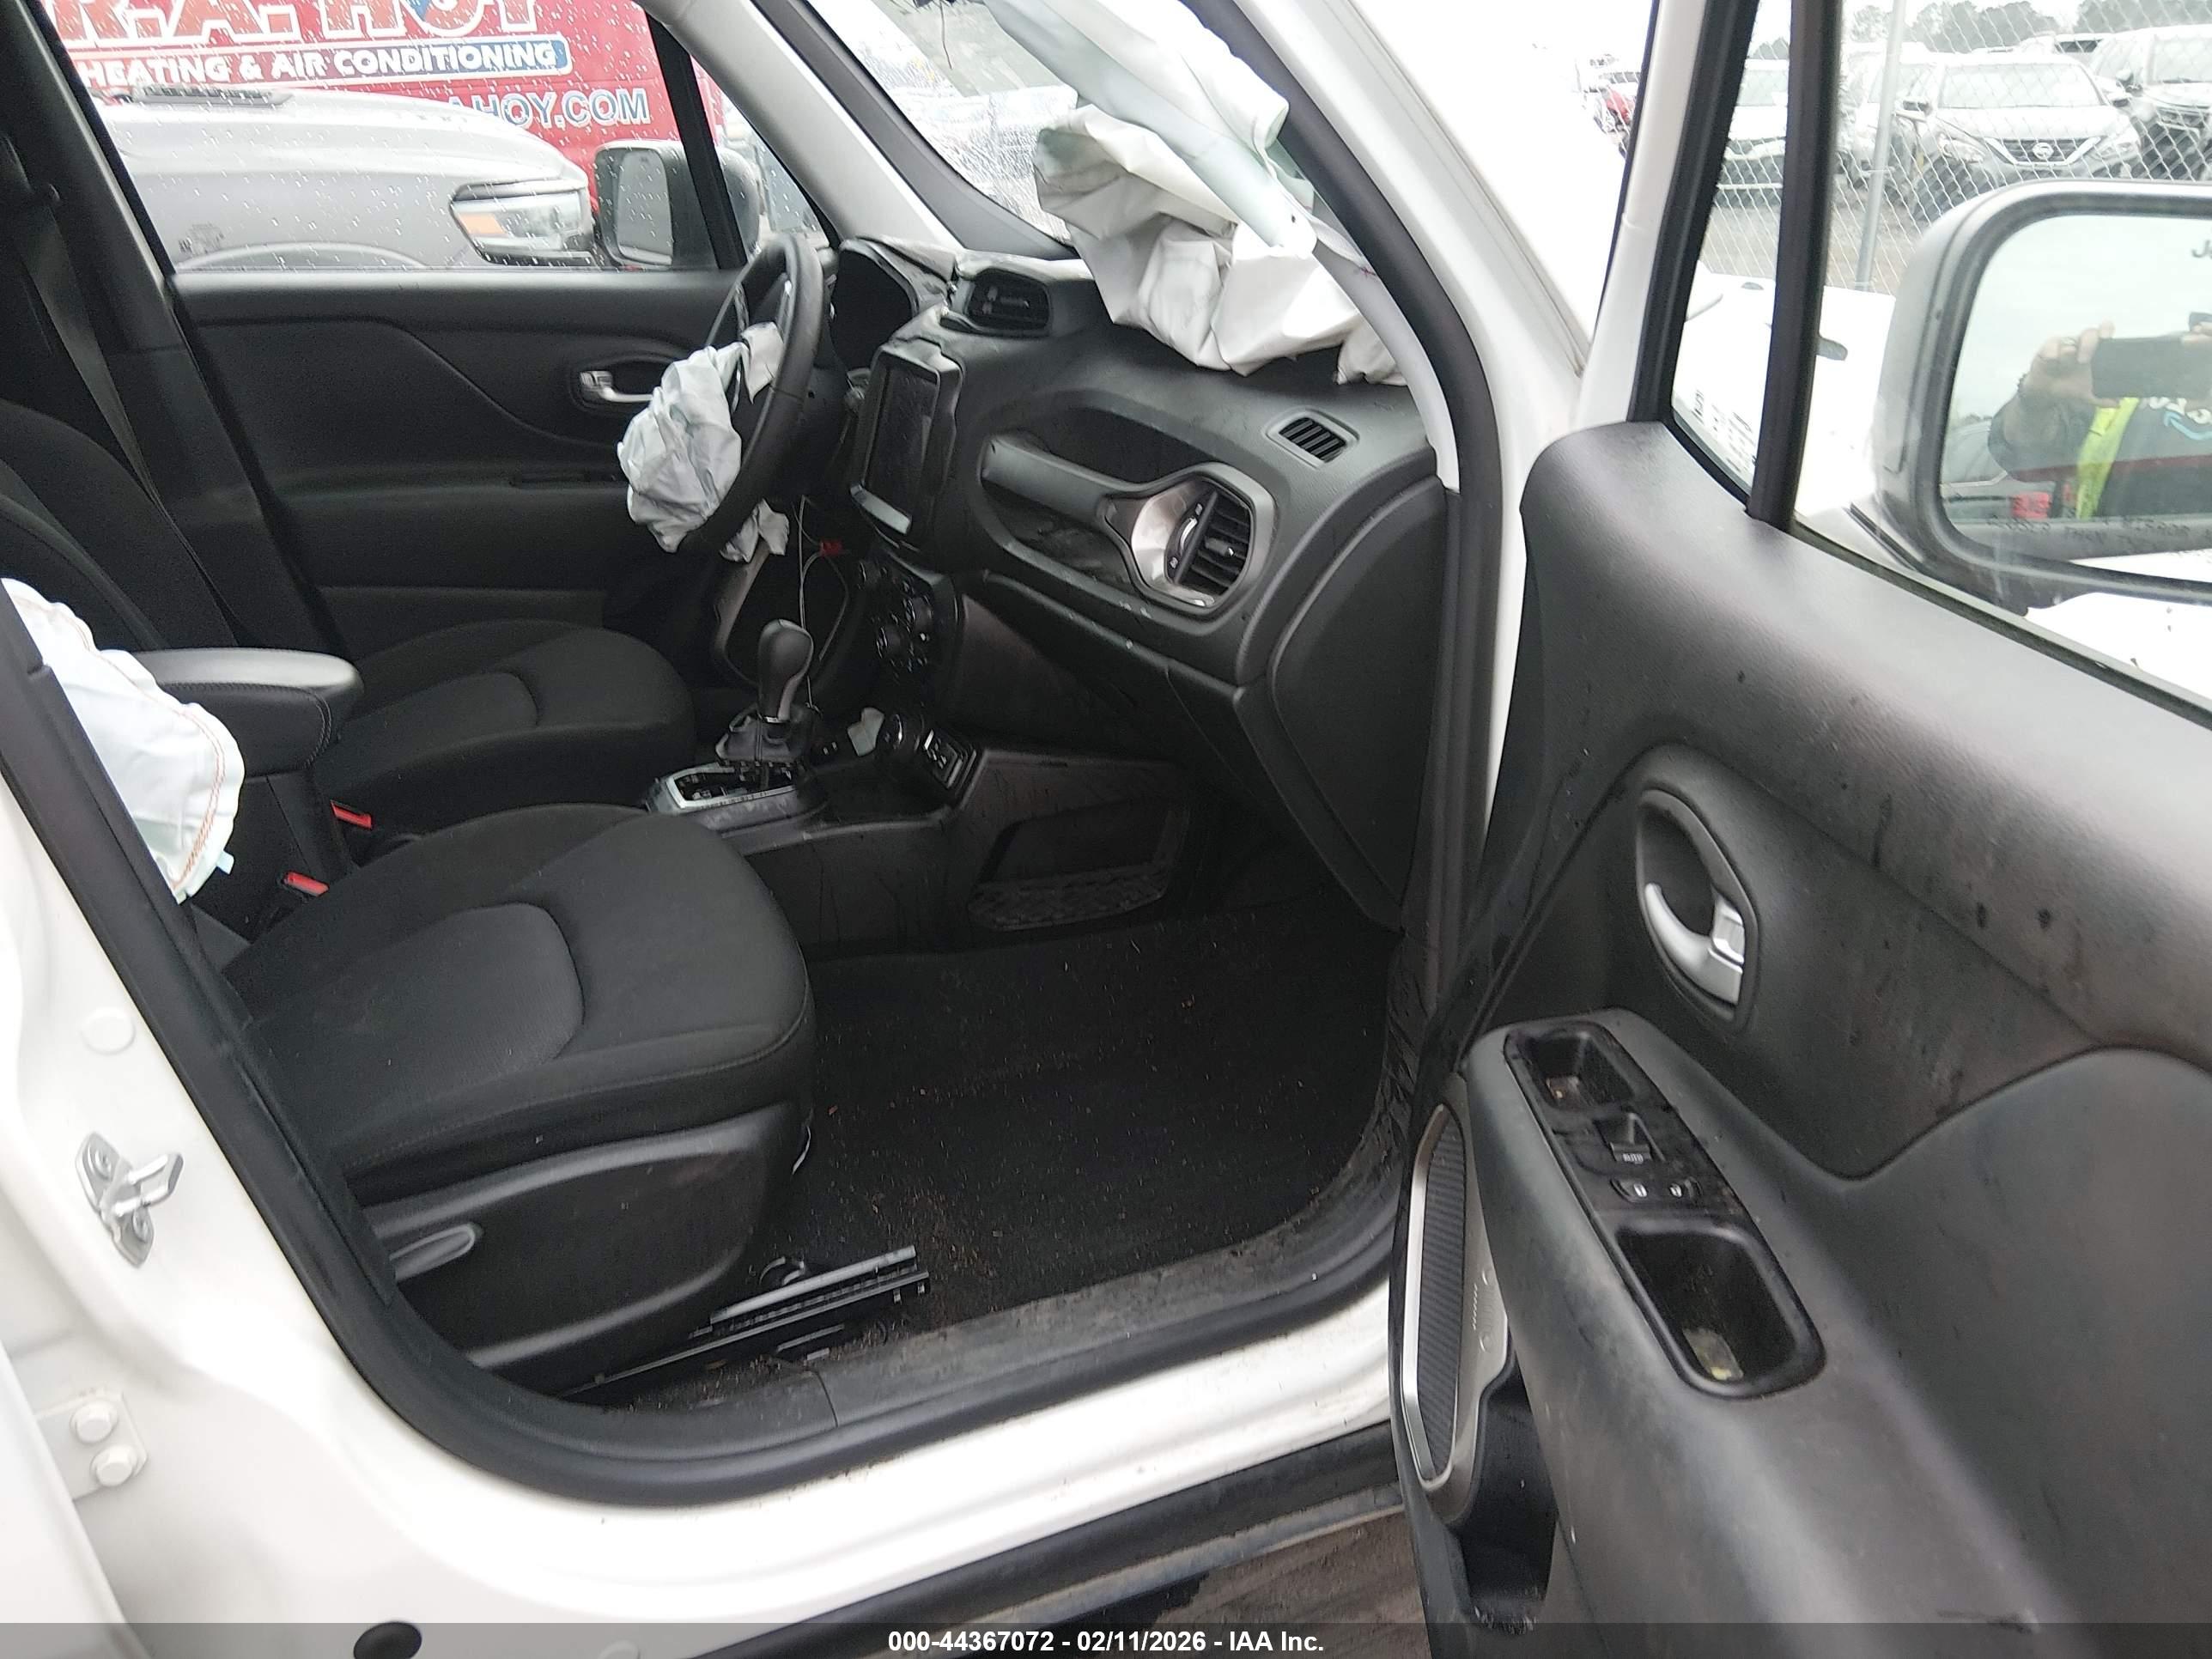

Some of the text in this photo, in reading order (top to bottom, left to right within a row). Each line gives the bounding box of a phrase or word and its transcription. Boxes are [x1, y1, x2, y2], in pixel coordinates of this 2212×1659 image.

[79, 40, 558, 87] HEATING & AIR CONDITIONING
[448, 87, 652, 129] HOY.COM
